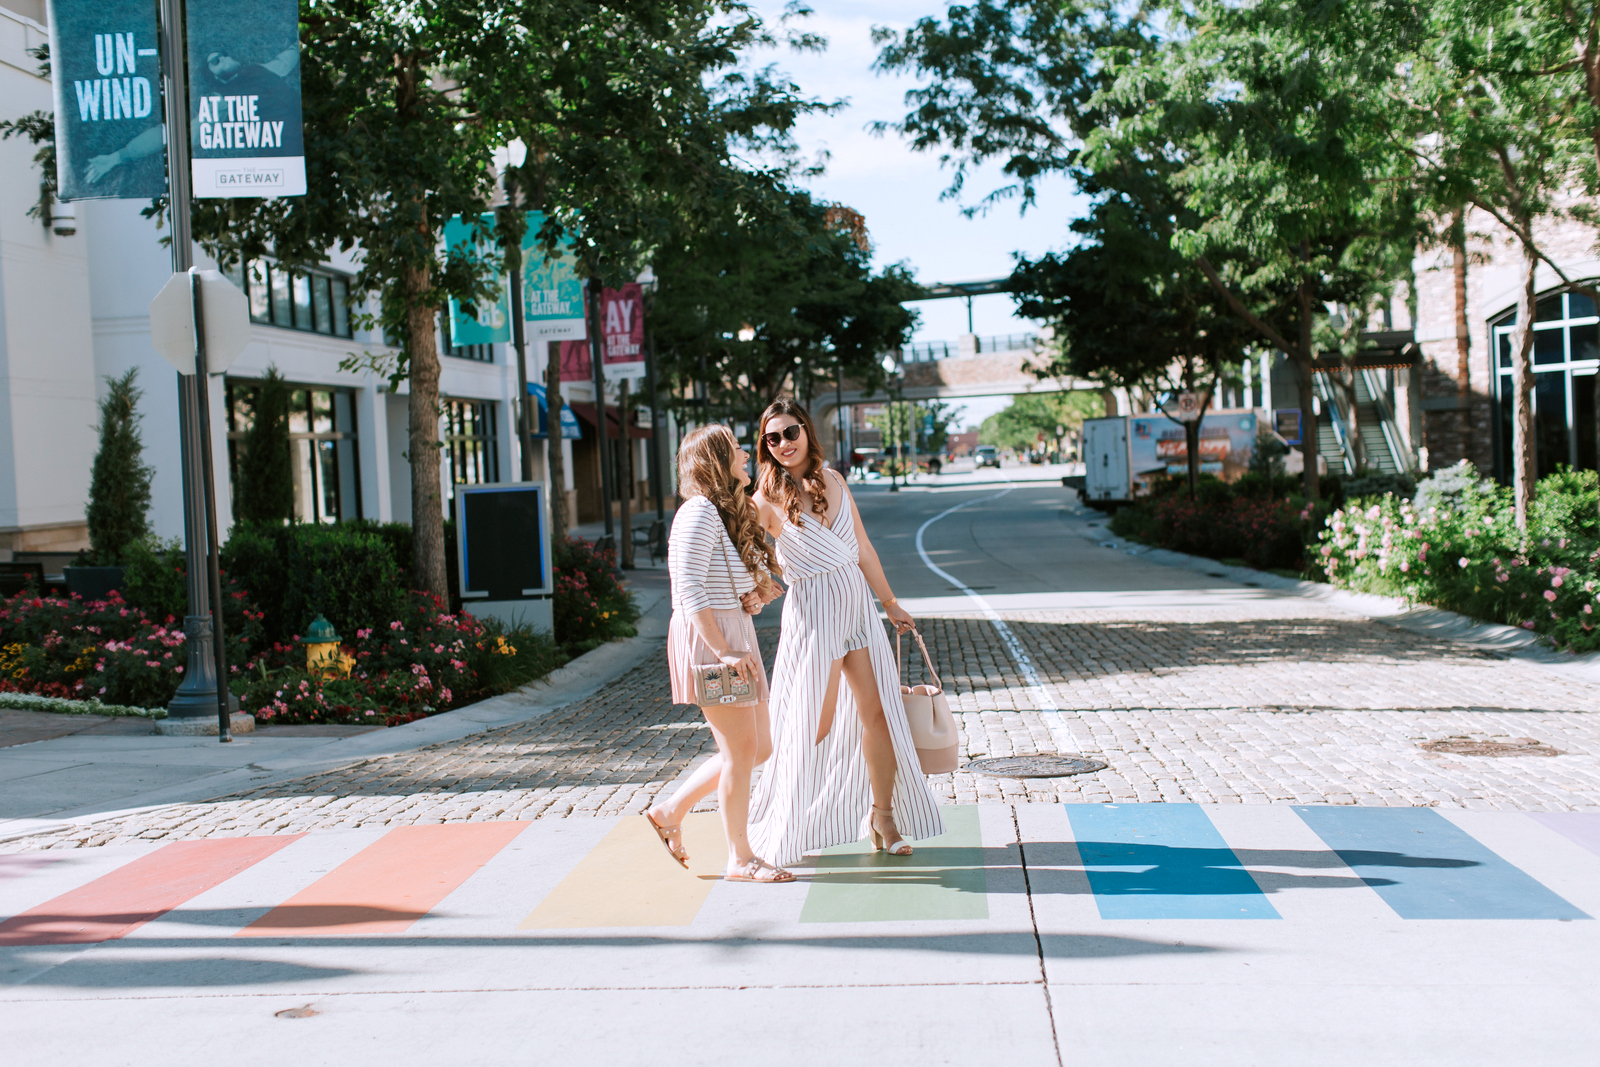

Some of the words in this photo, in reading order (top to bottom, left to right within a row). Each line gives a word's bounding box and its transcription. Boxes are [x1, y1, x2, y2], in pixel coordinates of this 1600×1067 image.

[95, 32, 157, 76] UN-
[74, 77, 152, 121] WIND
[198, 96, 221, 122] AT
[224, 95, 260, 121] THE
[200, 121, 284, 149] GATEWAY
[220, 173, 280, 184] GATEWAY
[531, 290, 541, 303] AT
[543, 289, 559, 302] THE
[531, 301, 571, 316] GATEWAY
[606, 299, 633, 333] AY
[607, 344, 640, 357] GATEWAY
